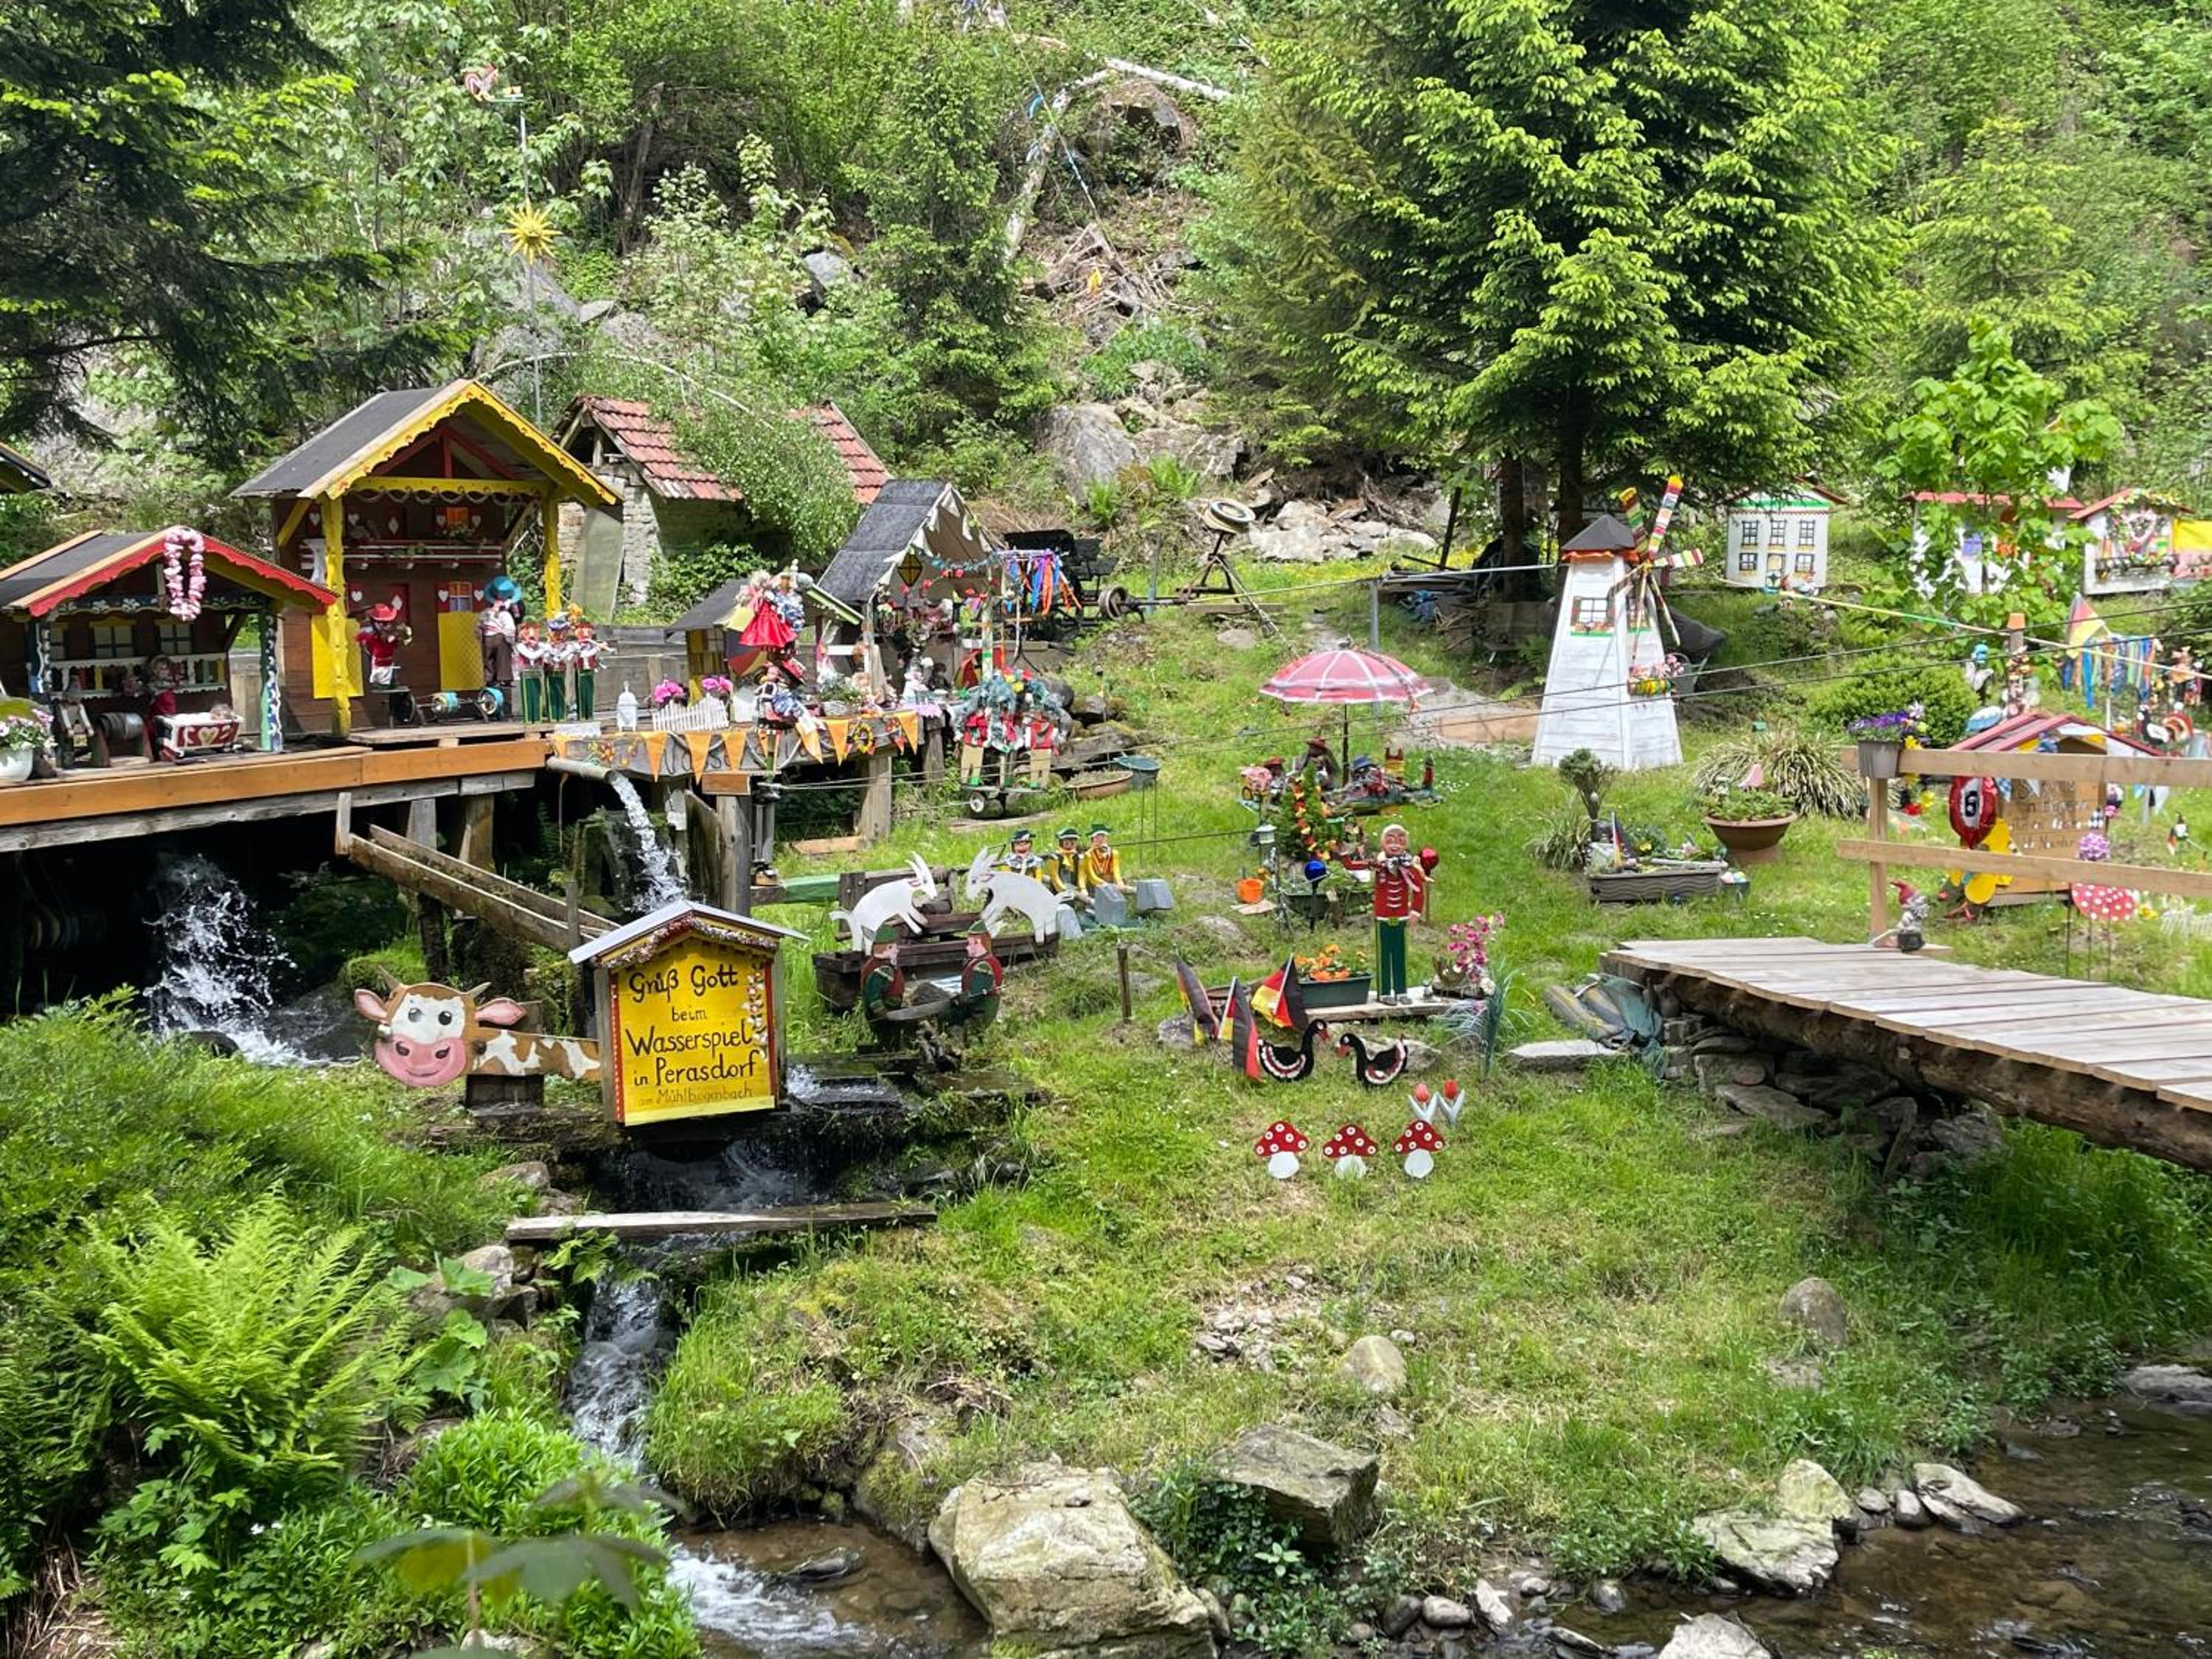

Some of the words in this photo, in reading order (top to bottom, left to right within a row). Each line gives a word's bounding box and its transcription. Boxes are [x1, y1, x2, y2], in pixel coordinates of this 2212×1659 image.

[690, 963, 737, 996] Gott
[672, 1006, 707, 1022] beim
[625, 1018, 752, 1059] Wasserspiel
[634, 1070, 649, 1086] in
[655, 1049, 759, 1086] Perasdorf
